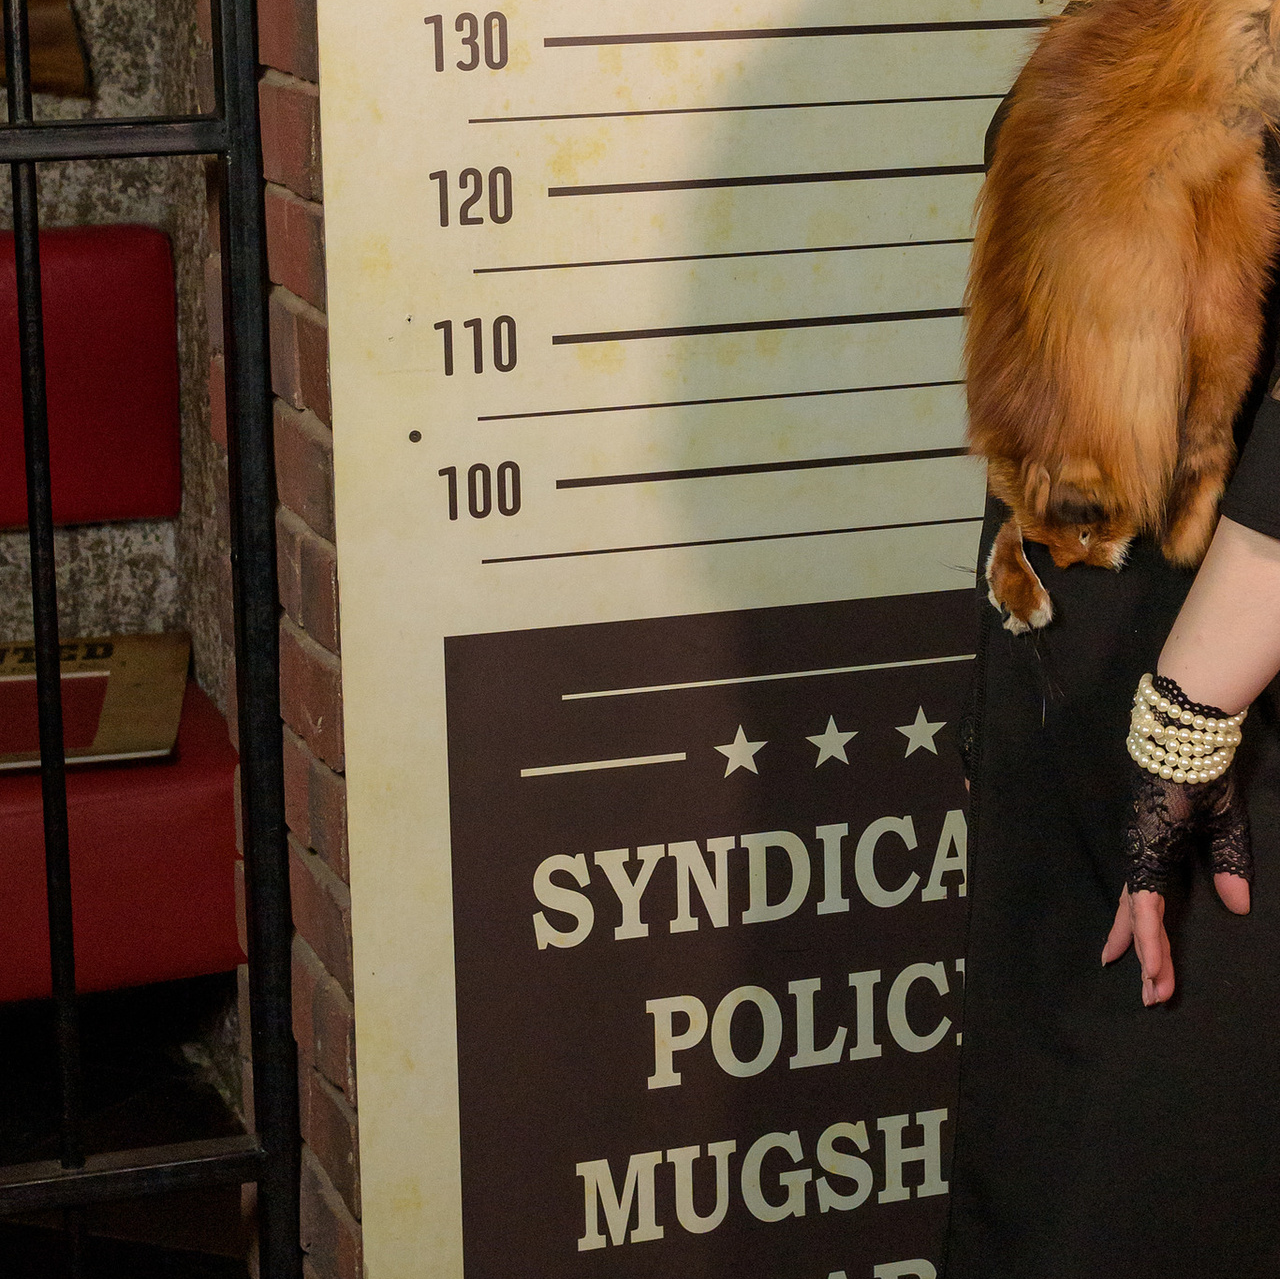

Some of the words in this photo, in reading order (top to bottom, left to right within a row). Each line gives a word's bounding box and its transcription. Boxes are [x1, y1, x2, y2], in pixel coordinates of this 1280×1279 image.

[423, 11, 509, 73] 130
[428, 165, 513, 228] 120
[433, 314, 518, 377] 110
[438, 460, 522, 521] 100
[532, 809, 968, 951] SYNDICA
[645, 958, 965, 1090] POLIC
[575, 1107, 949, 1253] MUGSH
